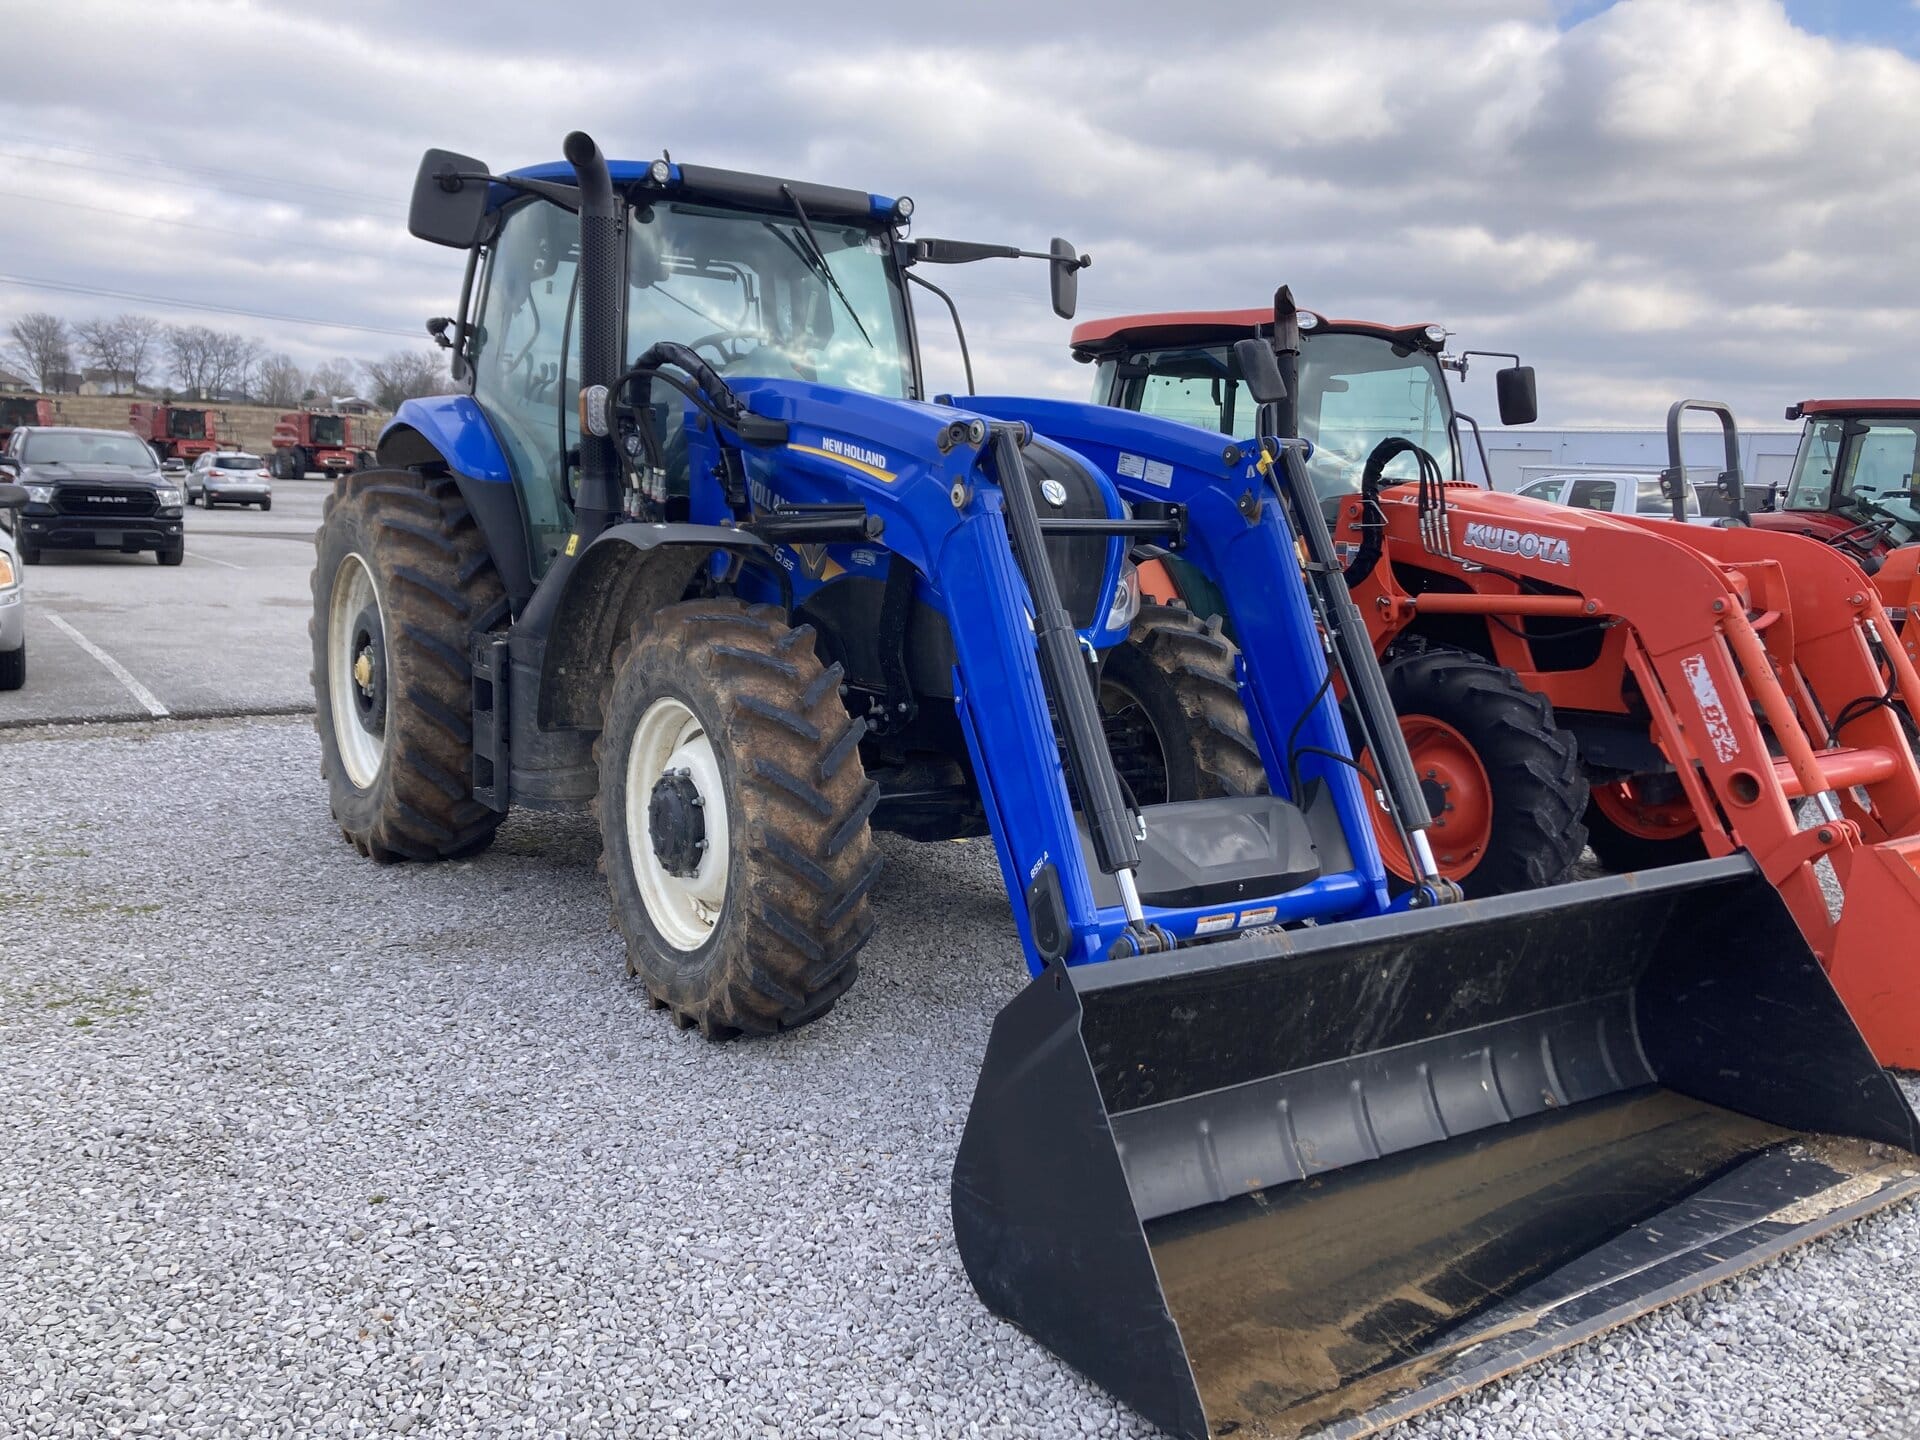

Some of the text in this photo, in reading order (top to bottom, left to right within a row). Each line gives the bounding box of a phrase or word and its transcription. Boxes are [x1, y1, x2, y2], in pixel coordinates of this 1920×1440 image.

[822, 437, 886, 469] NEW HOLLAND
[87, 495, 128, 503] RAM
[1463, 522, 1571, 566] KUBOTA
